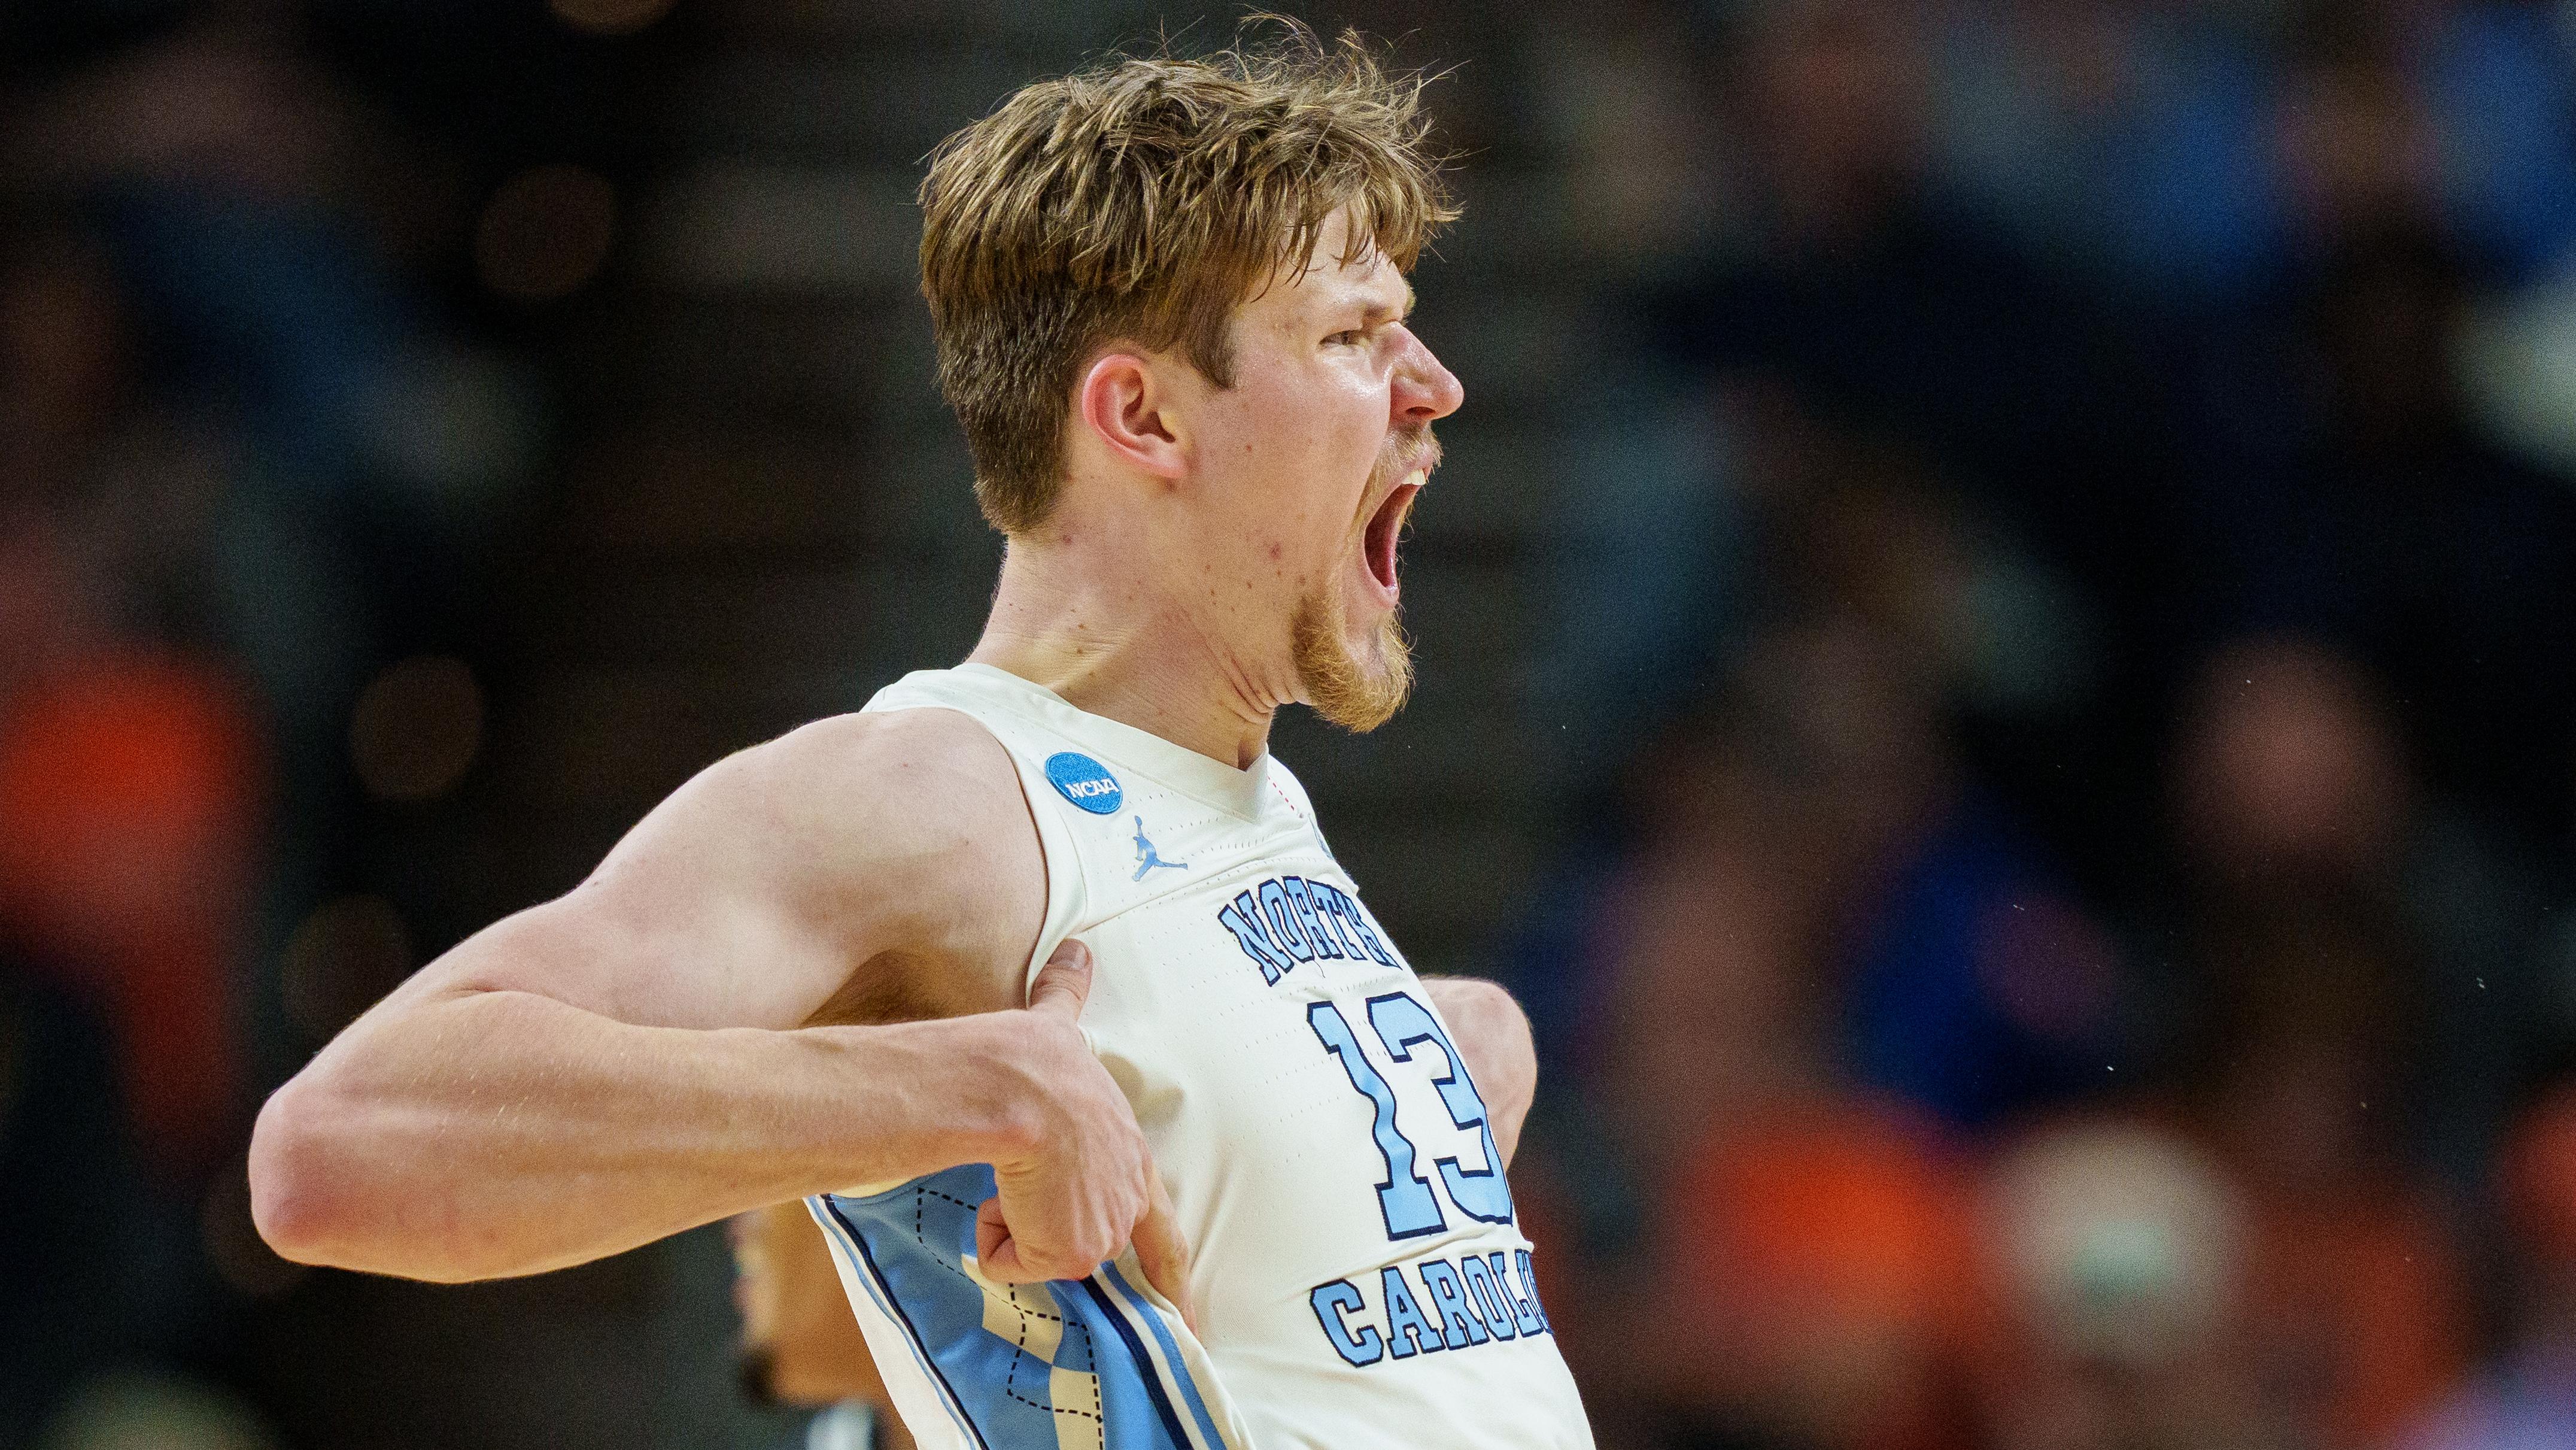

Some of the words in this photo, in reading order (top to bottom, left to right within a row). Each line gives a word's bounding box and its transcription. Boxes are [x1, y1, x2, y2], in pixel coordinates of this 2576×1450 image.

[1065, 778, 1119, 798] NCAA
[1217, 875, 1402, 987] NORTH
[1307, 991, 1513, 1241] 13
